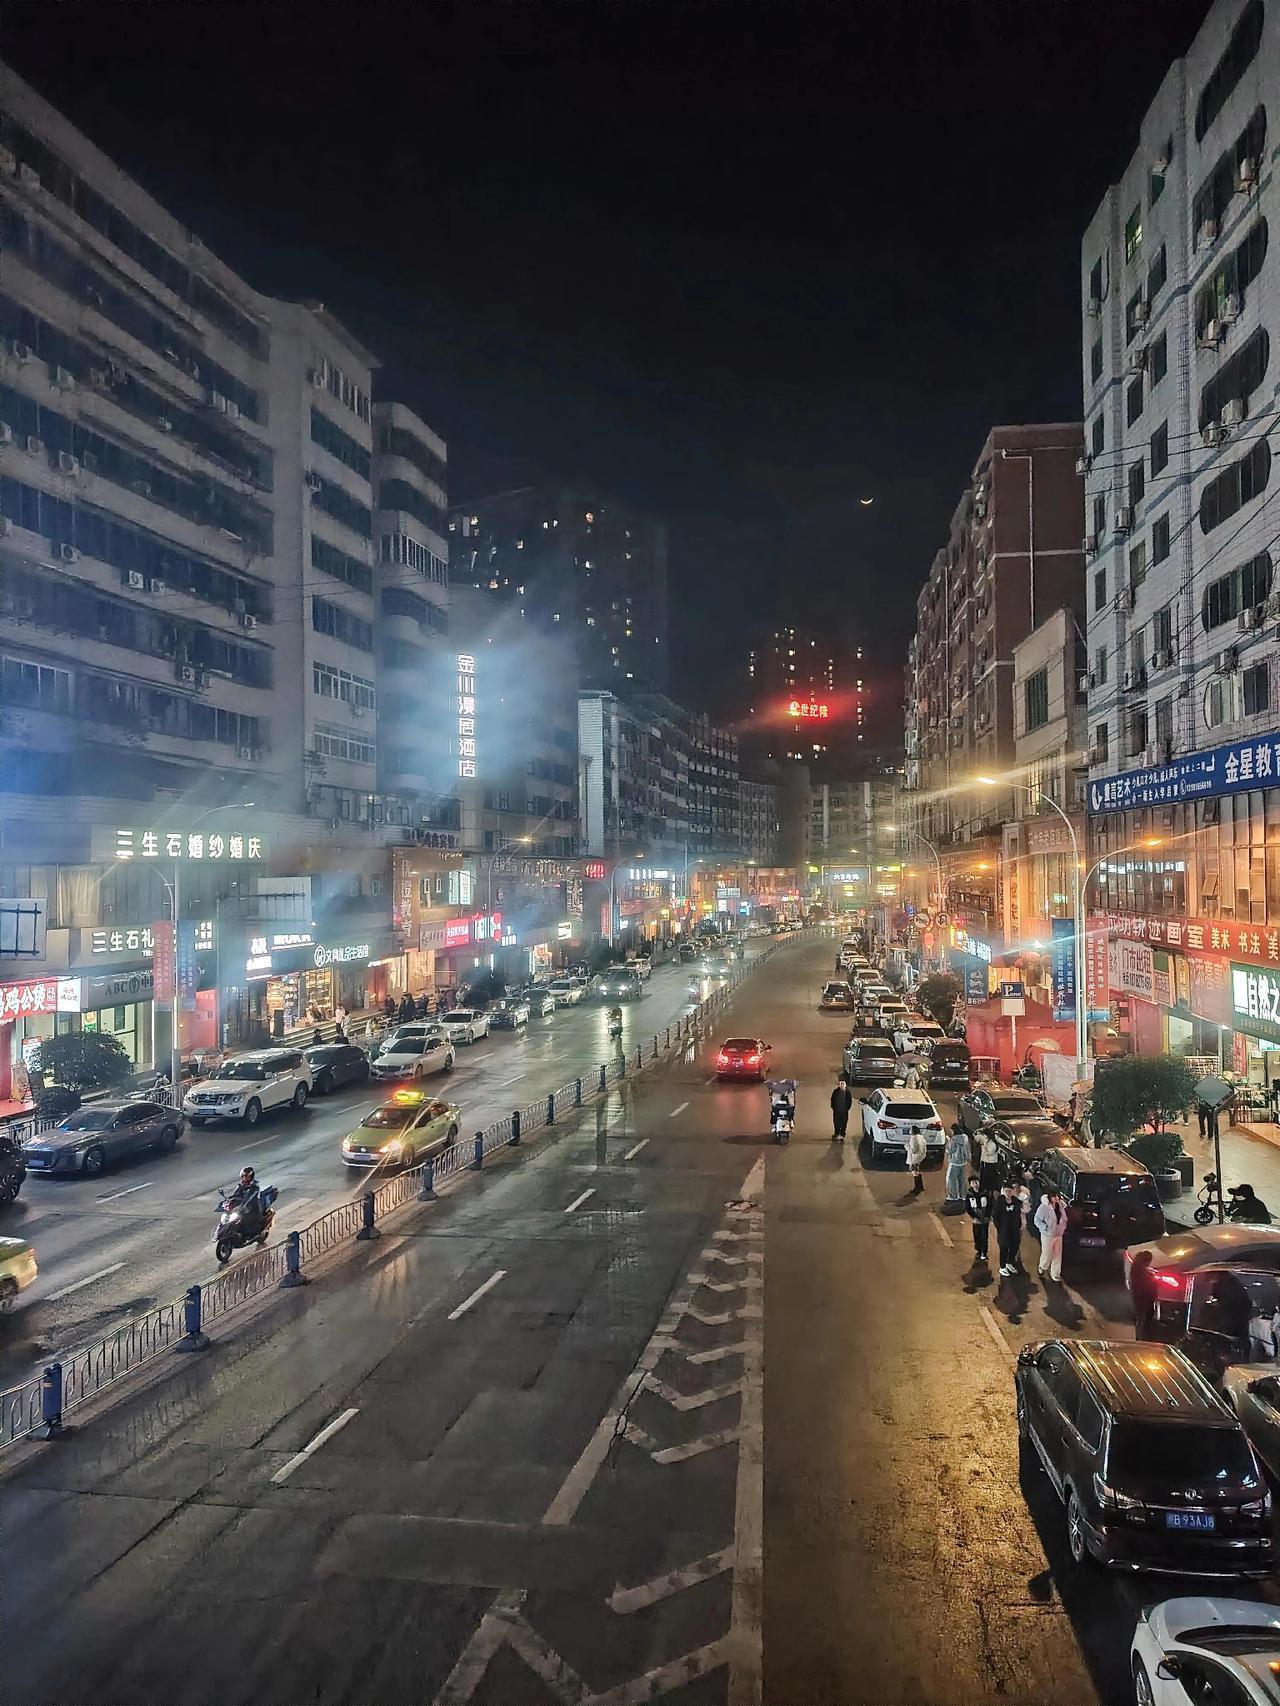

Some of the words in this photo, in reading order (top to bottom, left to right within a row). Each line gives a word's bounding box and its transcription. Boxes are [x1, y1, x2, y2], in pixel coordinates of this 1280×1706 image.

[458, 655, 476, 777] 金川漫居酒店
[801, 704, 829, 718] 世纪隆
[1225, 743, 1280, 784] 金星教
[115, 830, 262, 858] 三生石婚纱婚庆
[1211, 927, 1231, 950] 美术
[1238, 930, 1261, 956] 书法
[105, 981, 128, 996] ABC
[1004, 985, 1014, 997] P
